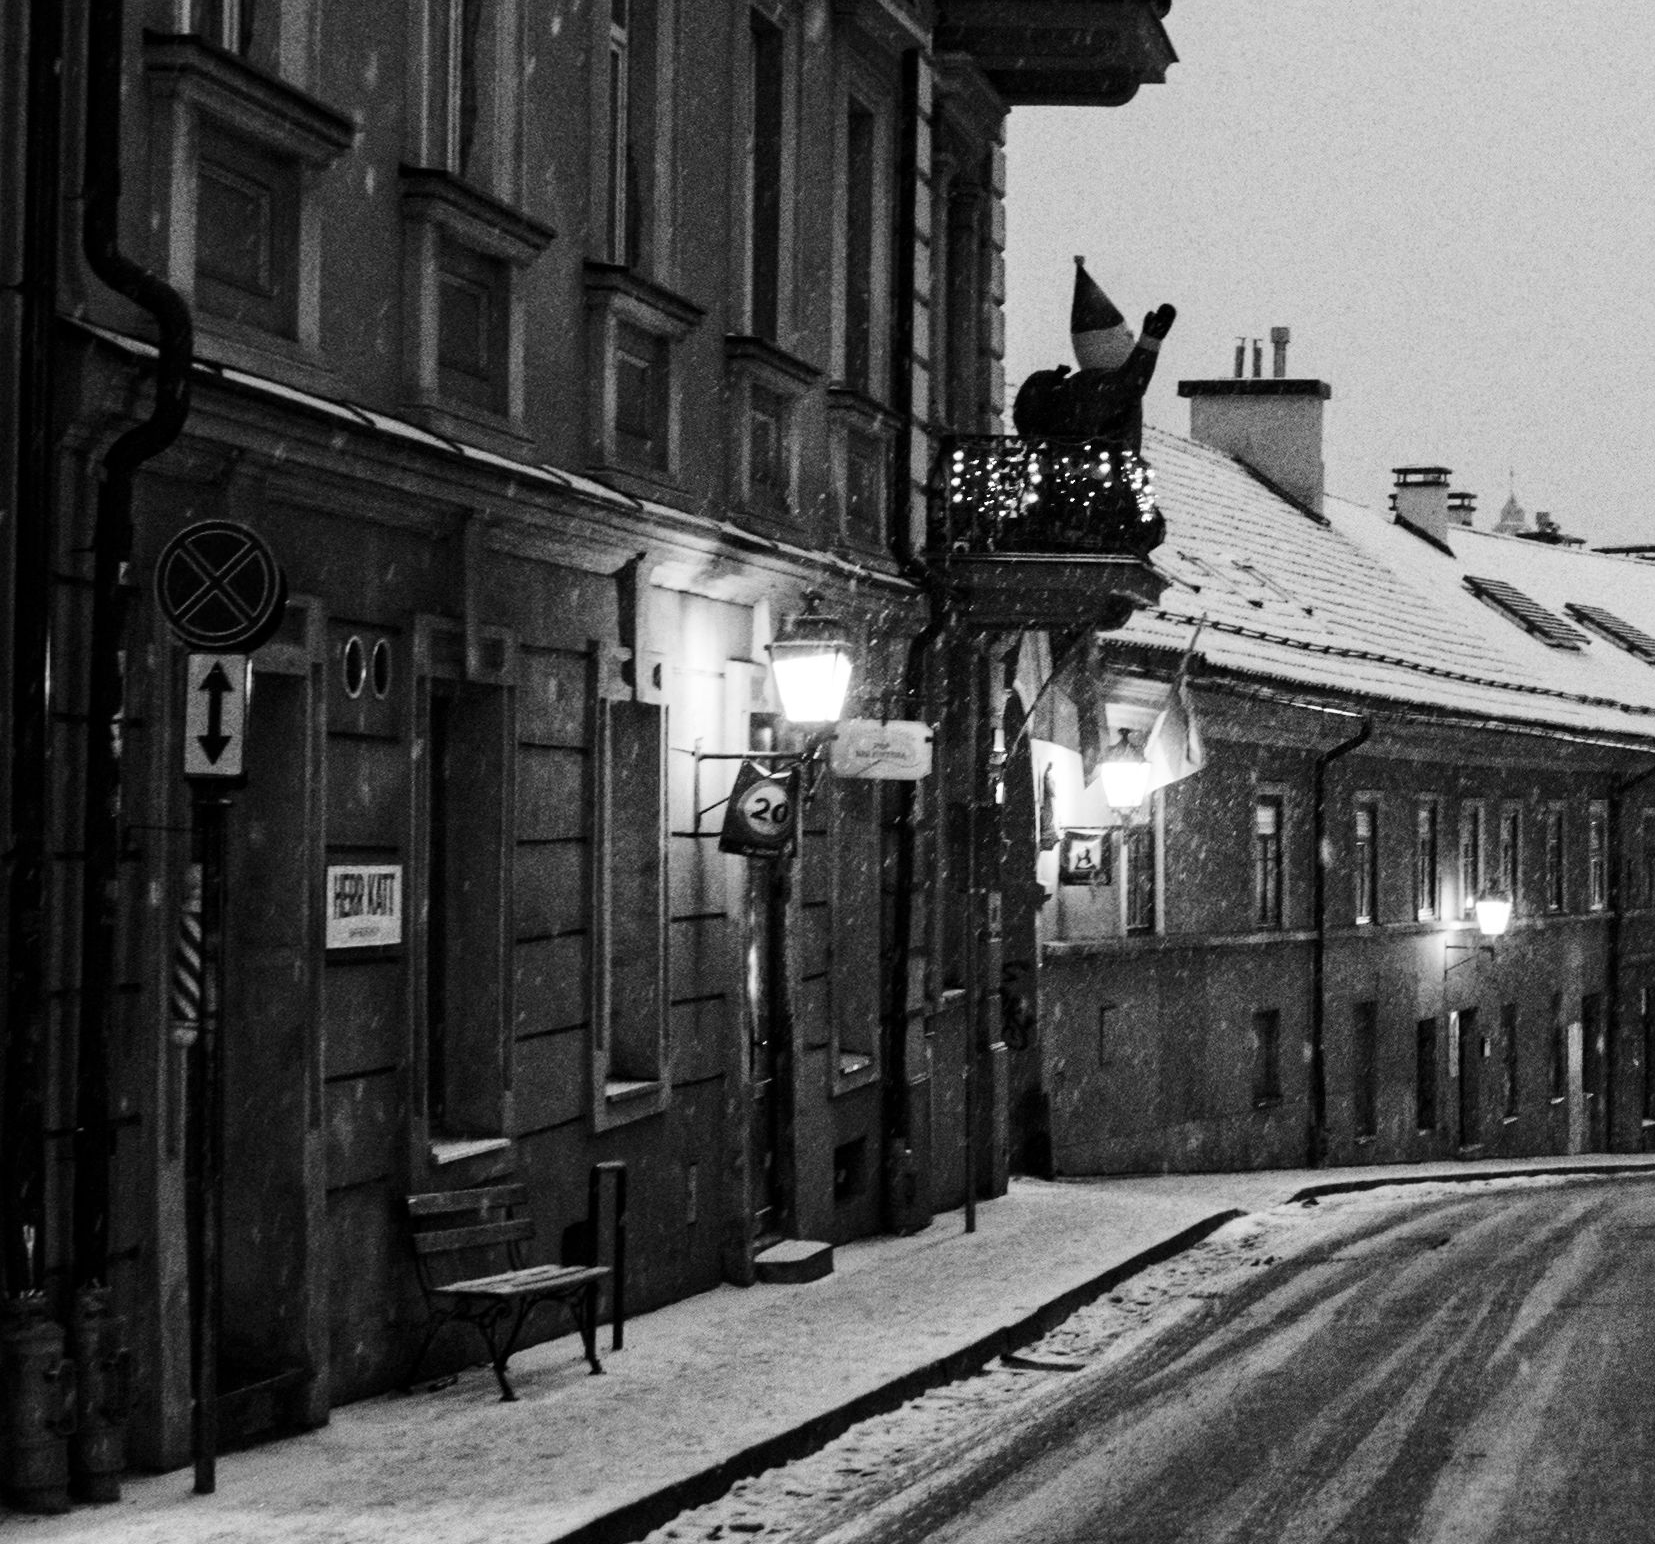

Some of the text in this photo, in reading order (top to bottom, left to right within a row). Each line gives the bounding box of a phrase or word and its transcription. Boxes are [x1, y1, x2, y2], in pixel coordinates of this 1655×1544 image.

[751, 797, 789, 824] 20
[334, 872, 395, 919] HERR KATT
